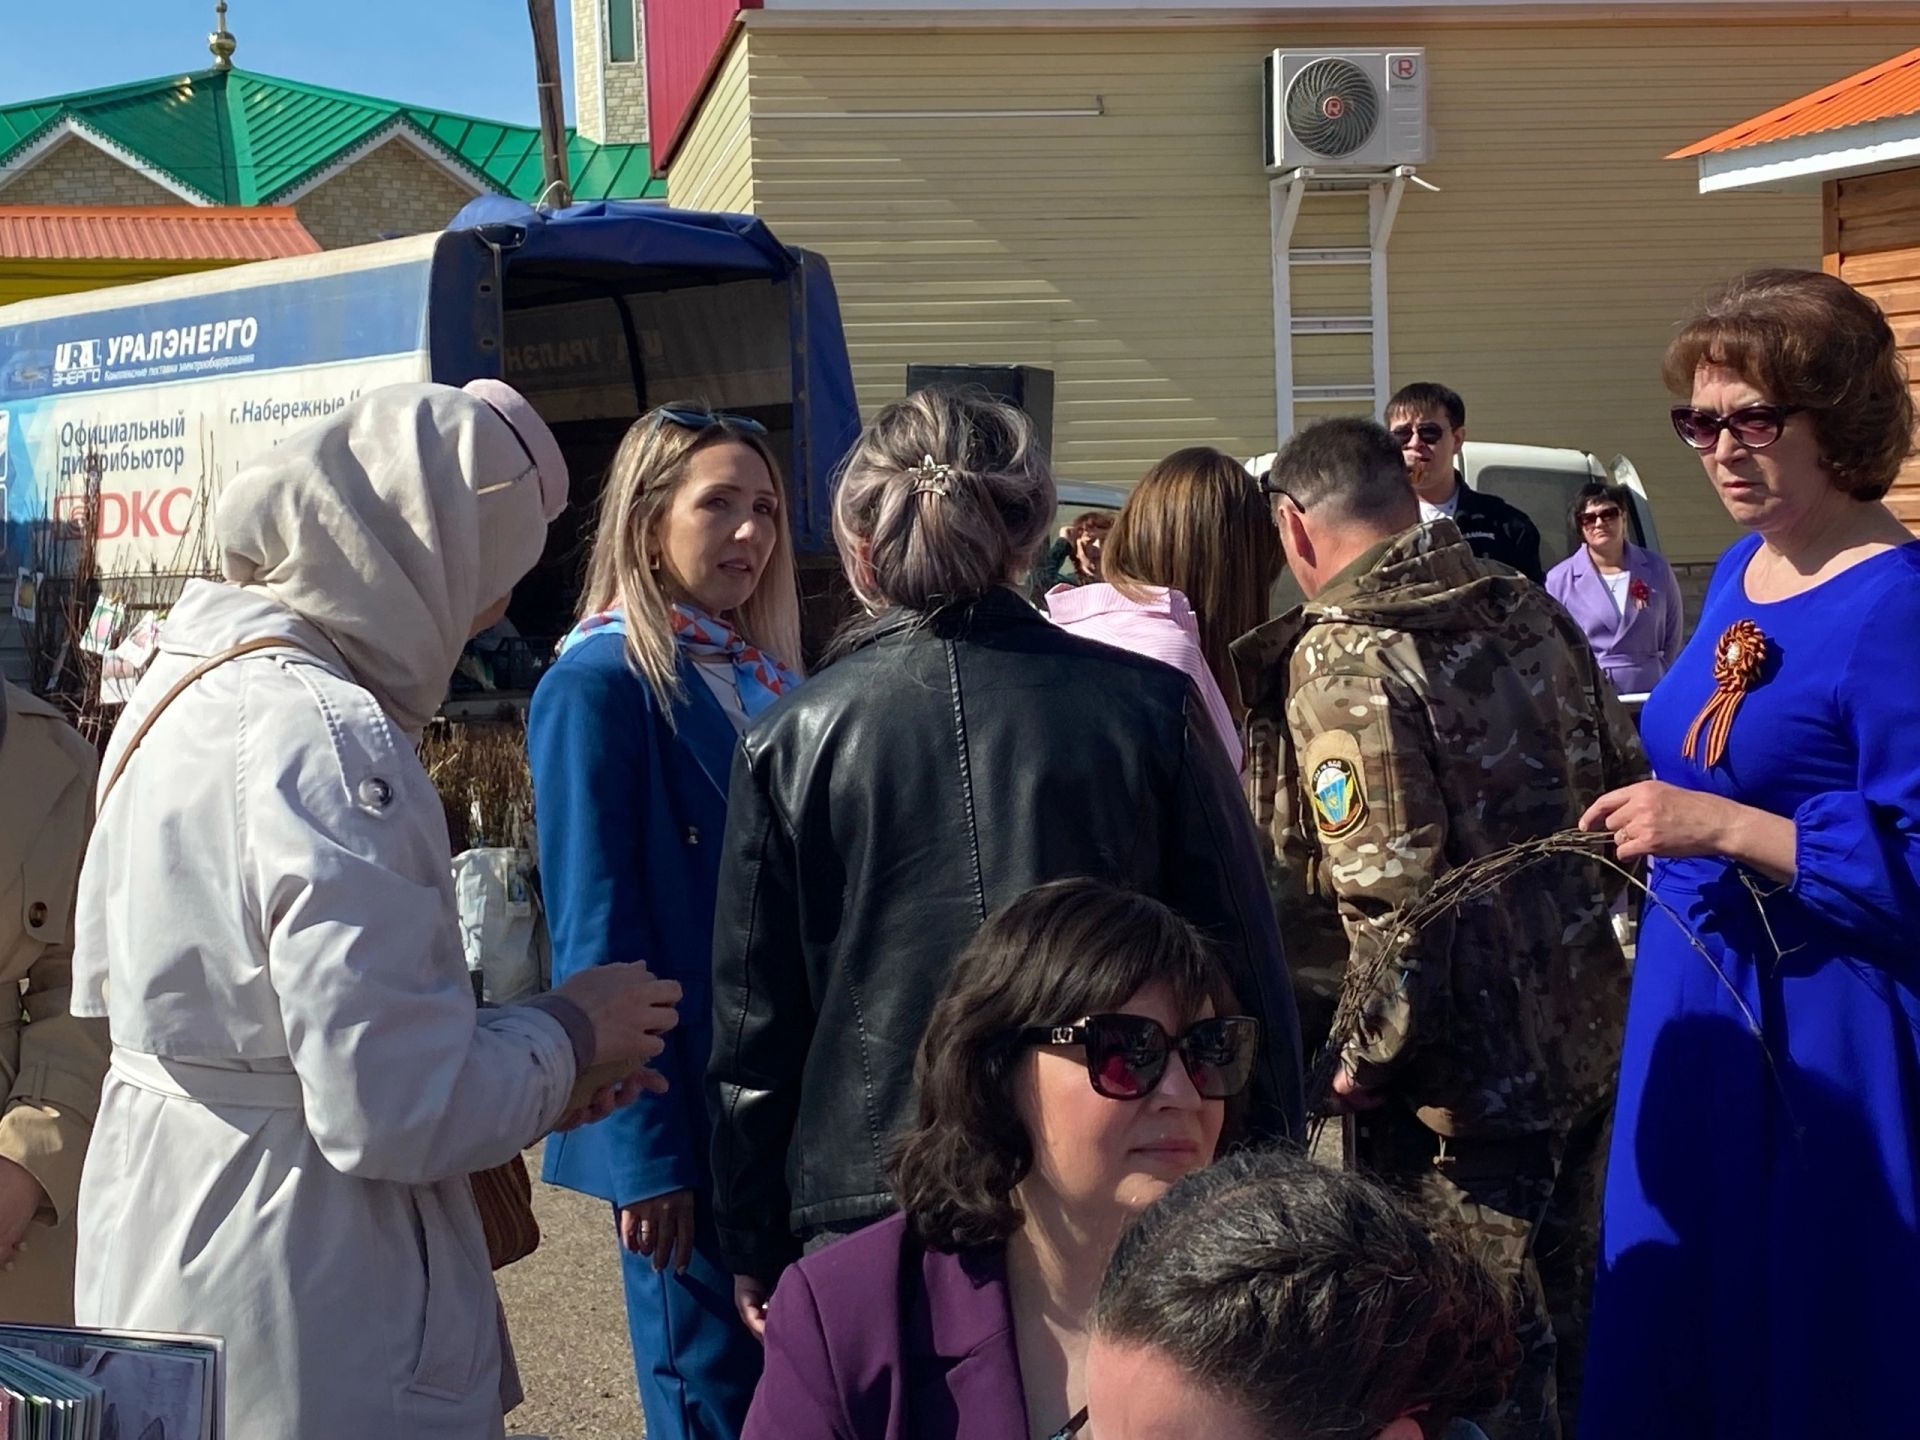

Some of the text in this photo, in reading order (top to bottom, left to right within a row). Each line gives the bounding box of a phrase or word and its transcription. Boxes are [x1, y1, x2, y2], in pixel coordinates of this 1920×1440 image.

[55, 339, 102, 372] URAL
[106, 316, 258, 366] УРАЛЭНЕРГО
[61, 409, 185, 449] Официальный
[230, 397, 345, 426] г. Набережные
[97, 487, 192, 540] DKC
